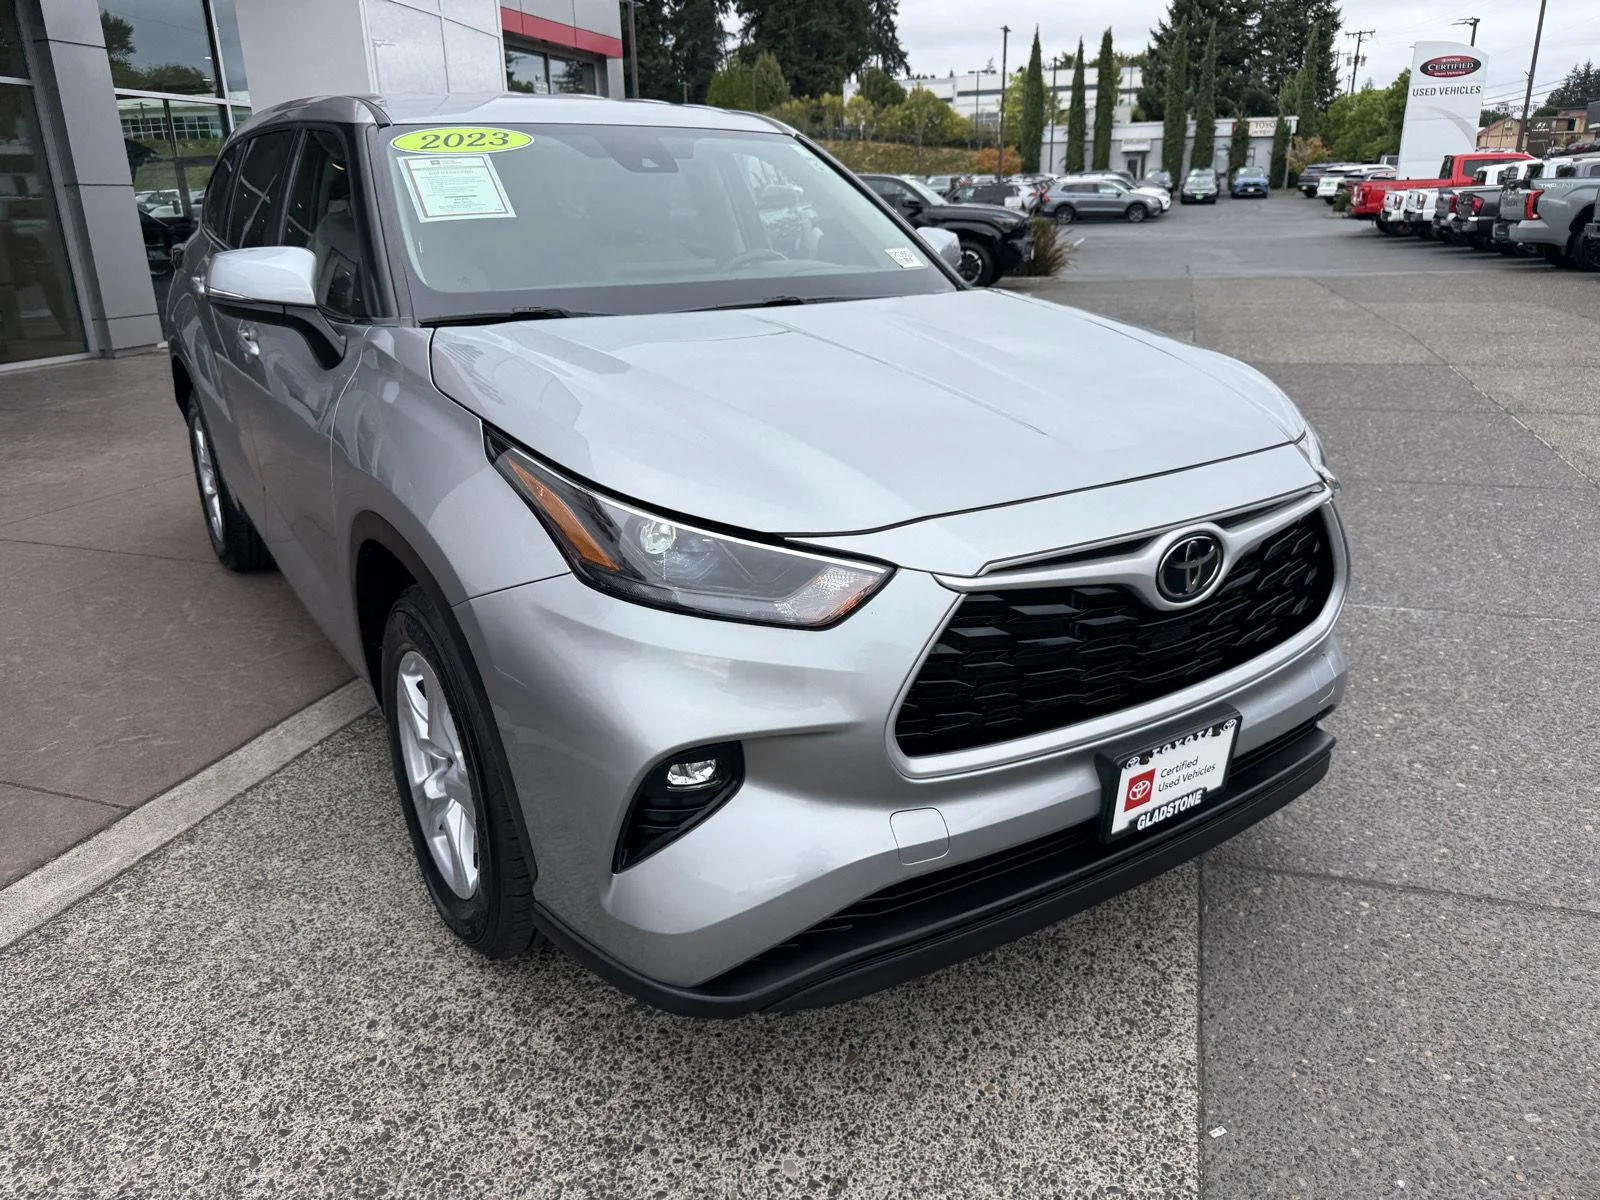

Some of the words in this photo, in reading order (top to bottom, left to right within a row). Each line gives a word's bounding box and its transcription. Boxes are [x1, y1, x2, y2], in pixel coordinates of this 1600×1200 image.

[1428, 62, 1474, 71] CERTIFIED
[1412, 87, 1437, 97] USED
[1439, 85, 1482, 96] VEHICLES
[420, 132, 509, 149] 2023
[1160, 756, 1199, 778] Certified
[1158, 775, 1181, 793] Used
[1182, 763, 1217, 783] Vehicles
[1137, 789, 1204, 831] GLADSTONE
